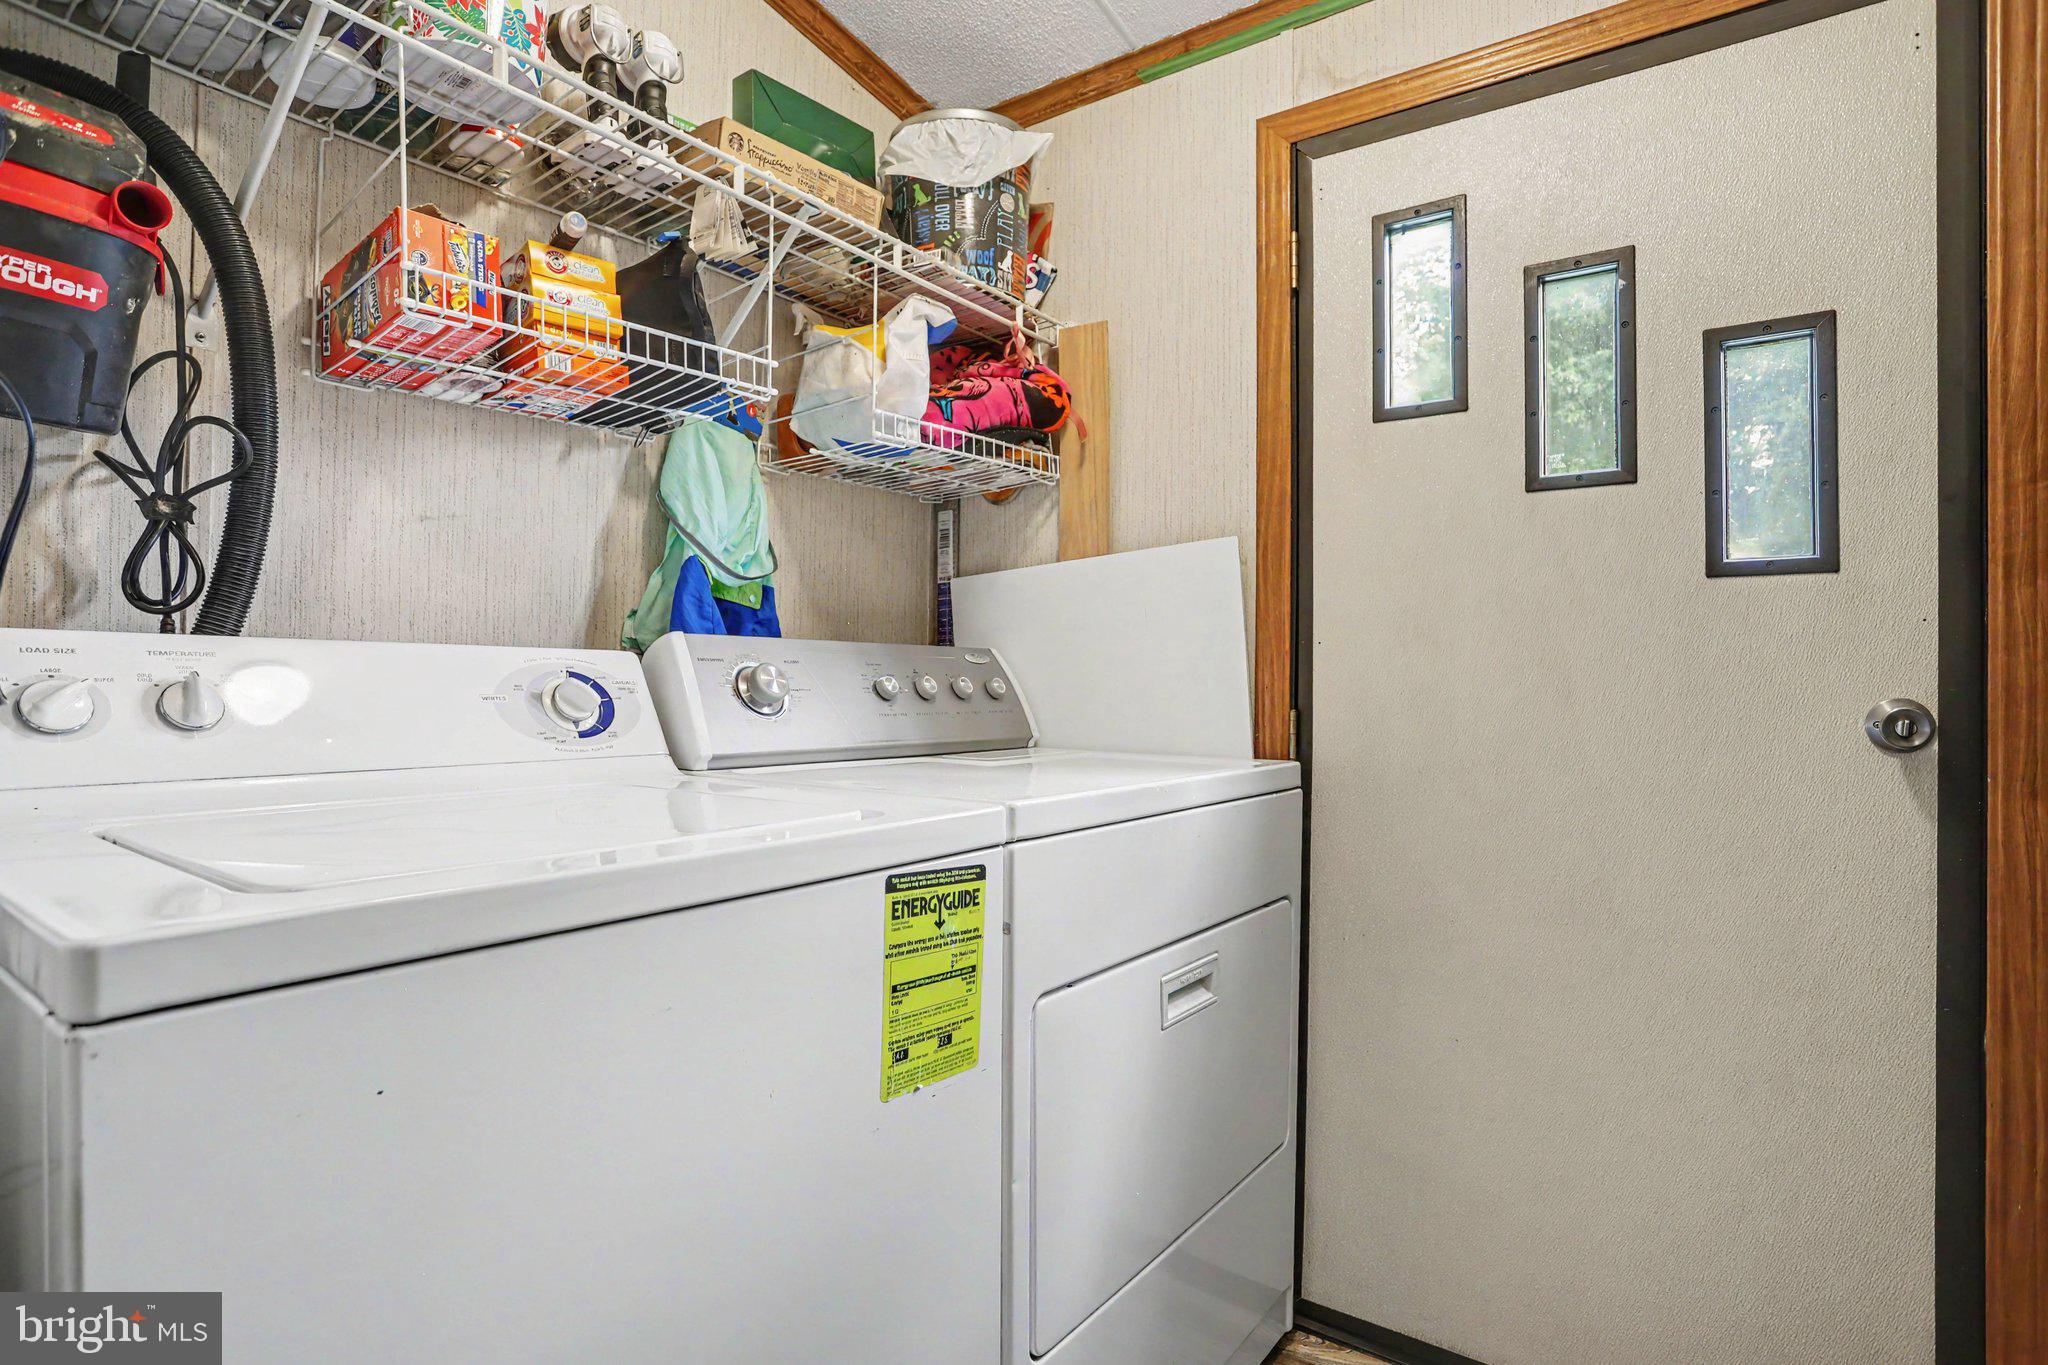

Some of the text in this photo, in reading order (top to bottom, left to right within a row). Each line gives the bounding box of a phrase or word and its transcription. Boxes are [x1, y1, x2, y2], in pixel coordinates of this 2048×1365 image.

[935, 203, 951, 232] OVER
[997, 207, 1014, 251] PLAY
[369, 270, 383, 326] Fabulos
[146, 650, 217, 658] TEMPERATURE
[891, 887, 981, 922] ENERGYGUIDE
